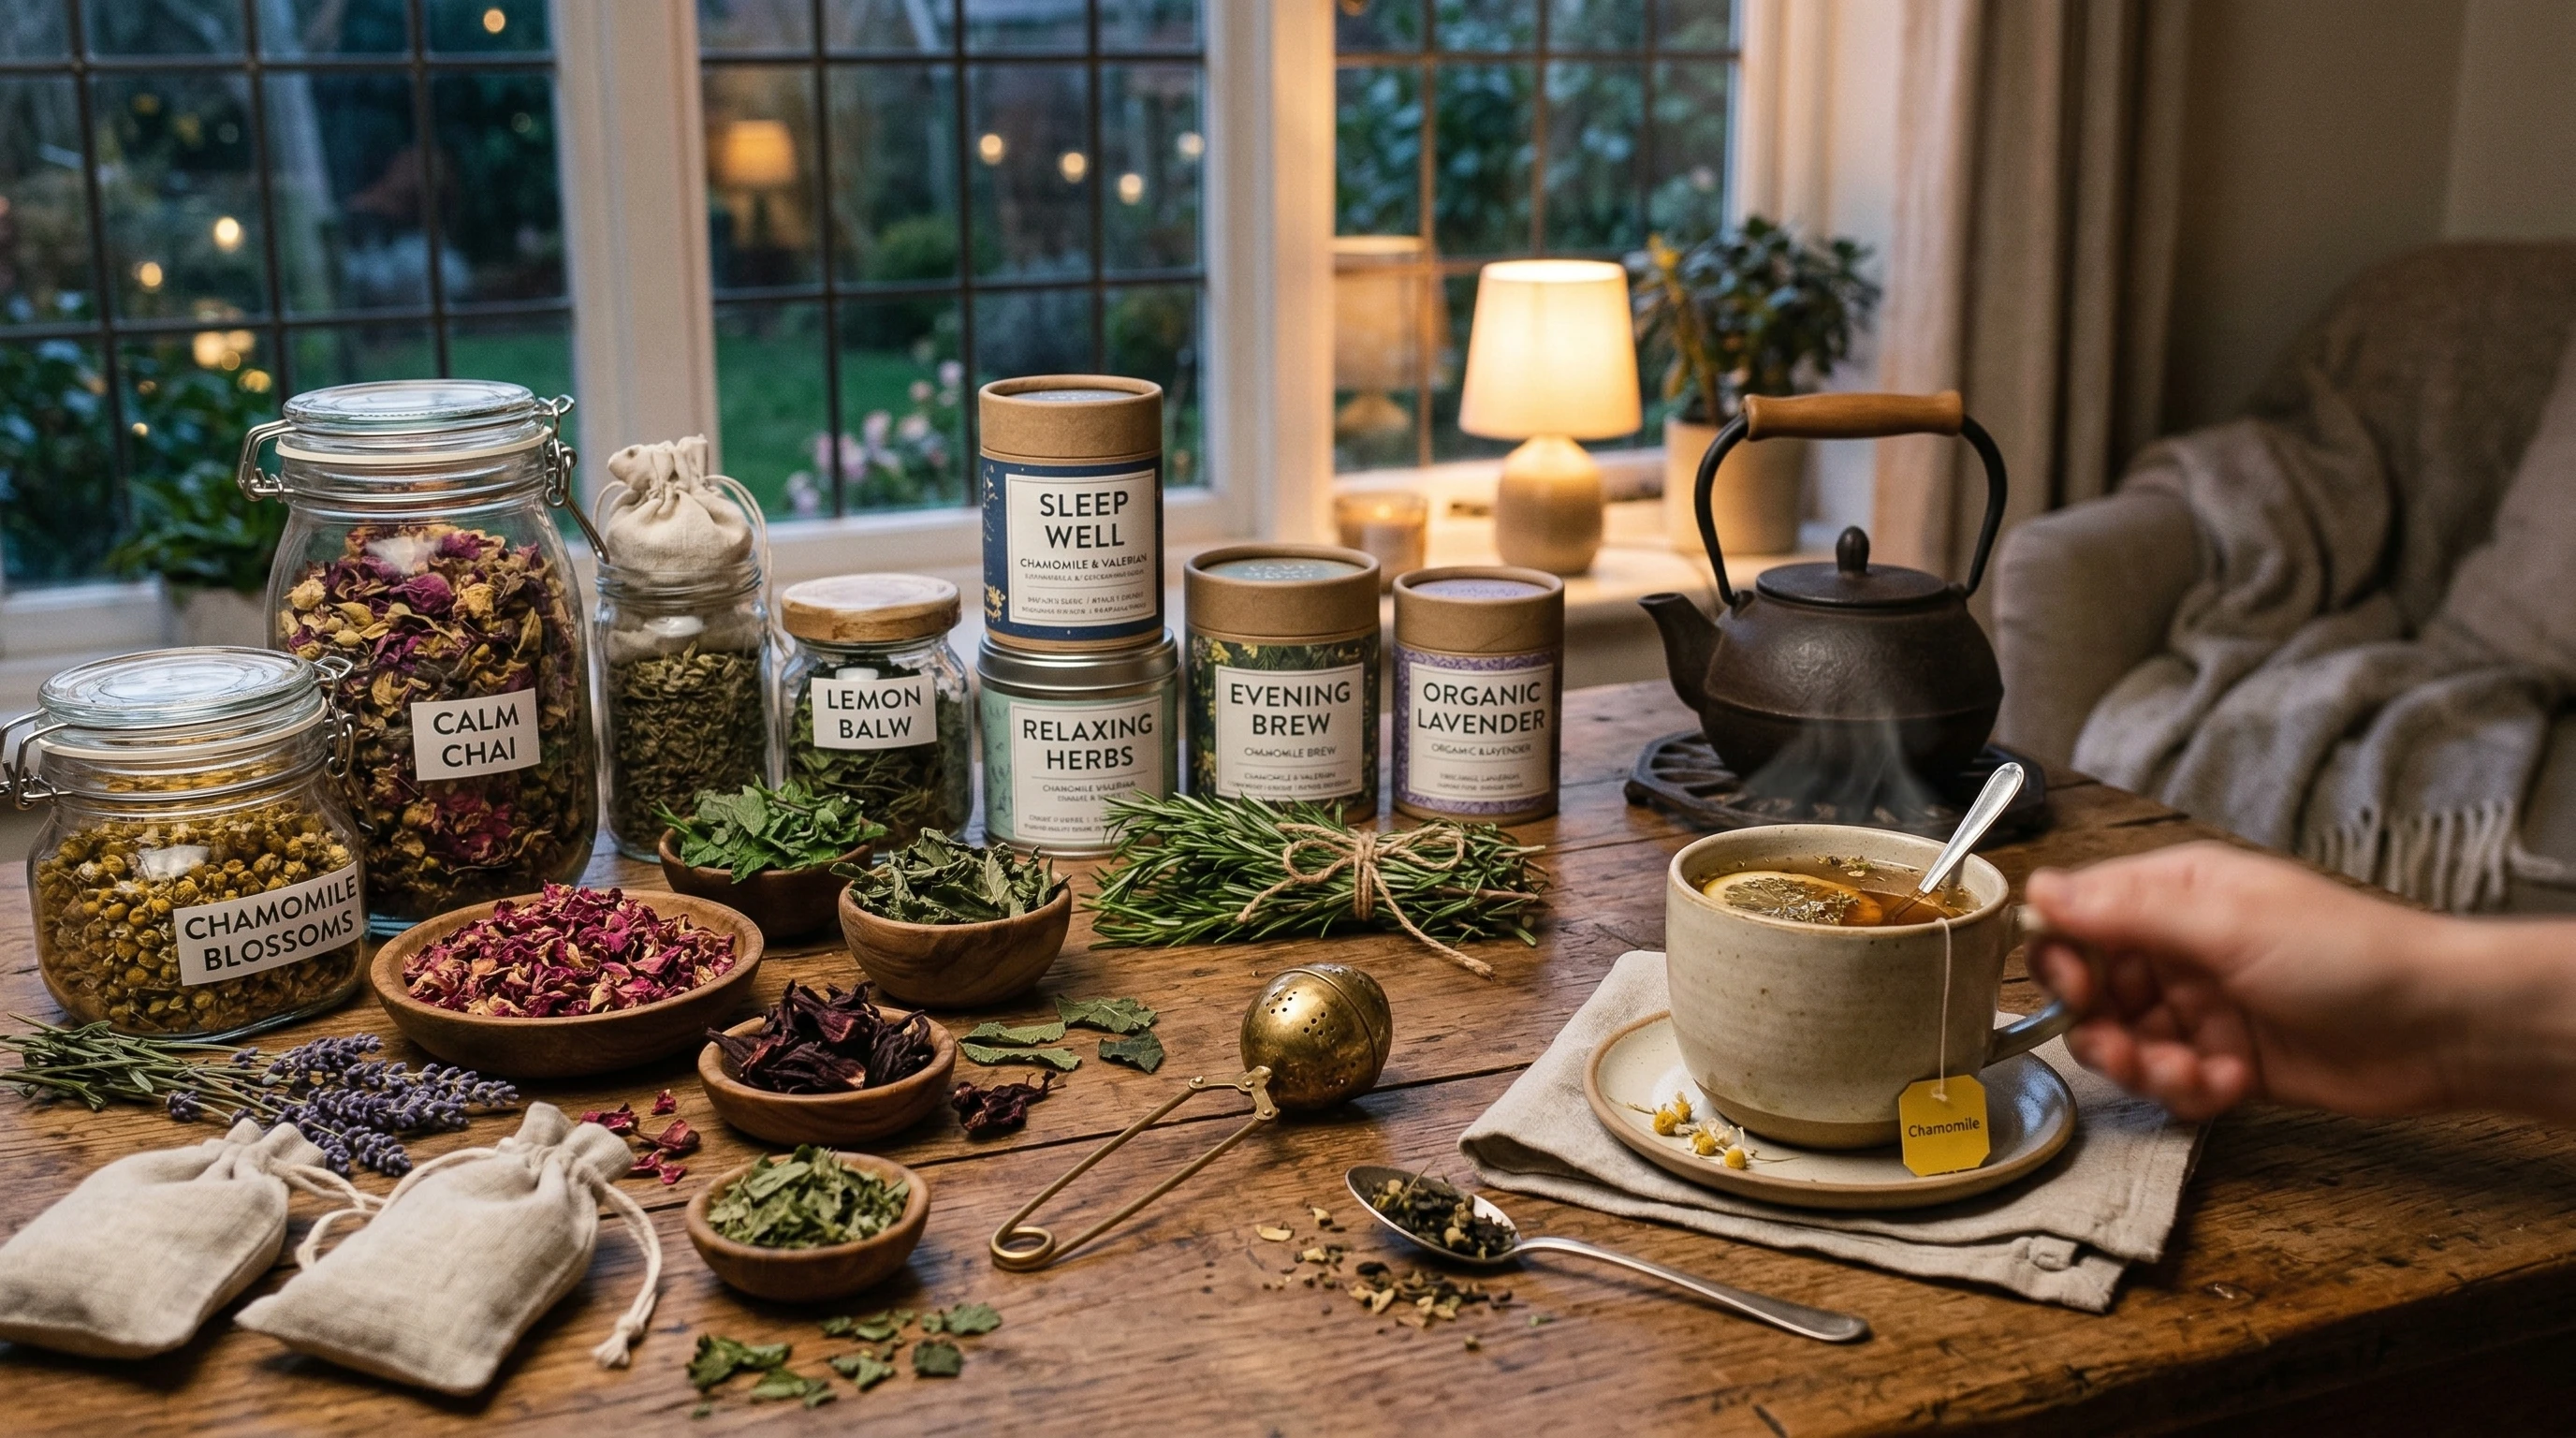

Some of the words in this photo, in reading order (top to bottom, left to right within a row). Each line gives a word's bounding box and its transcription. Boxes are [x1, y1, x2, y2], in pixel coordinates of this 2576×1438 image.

[1040, 491, 1129, 517] SLEEP
[1045, 523, 1125, 549] WELL
[1019, 558, 1089, 569] CHAMOMILE
[827, 685, 921, 710] LEMON
[1230, 681, 1351, 708] EVENING
[1423, 682, 1542, 706] ORGANIC
[432, 702, 520, 735] CALM
[840, 716, 912, 739] BALW
[1023, 713, 1153, 741] RELAXING
[1252, 712, 1331, 736] BREW
[1417, 708, 1545, 735] LAVENDER
[441, 736, 516, 768] CHAI
[1046, 746, 1134, 770] HERBS
[1307, 745, 1337, 756] BREW
[184, 874, 357, 940] CHAMOMILE
[203, 910, 354, 972] BLOSSOMS
[1908, 1117, 1981, 1137] Chamomile
